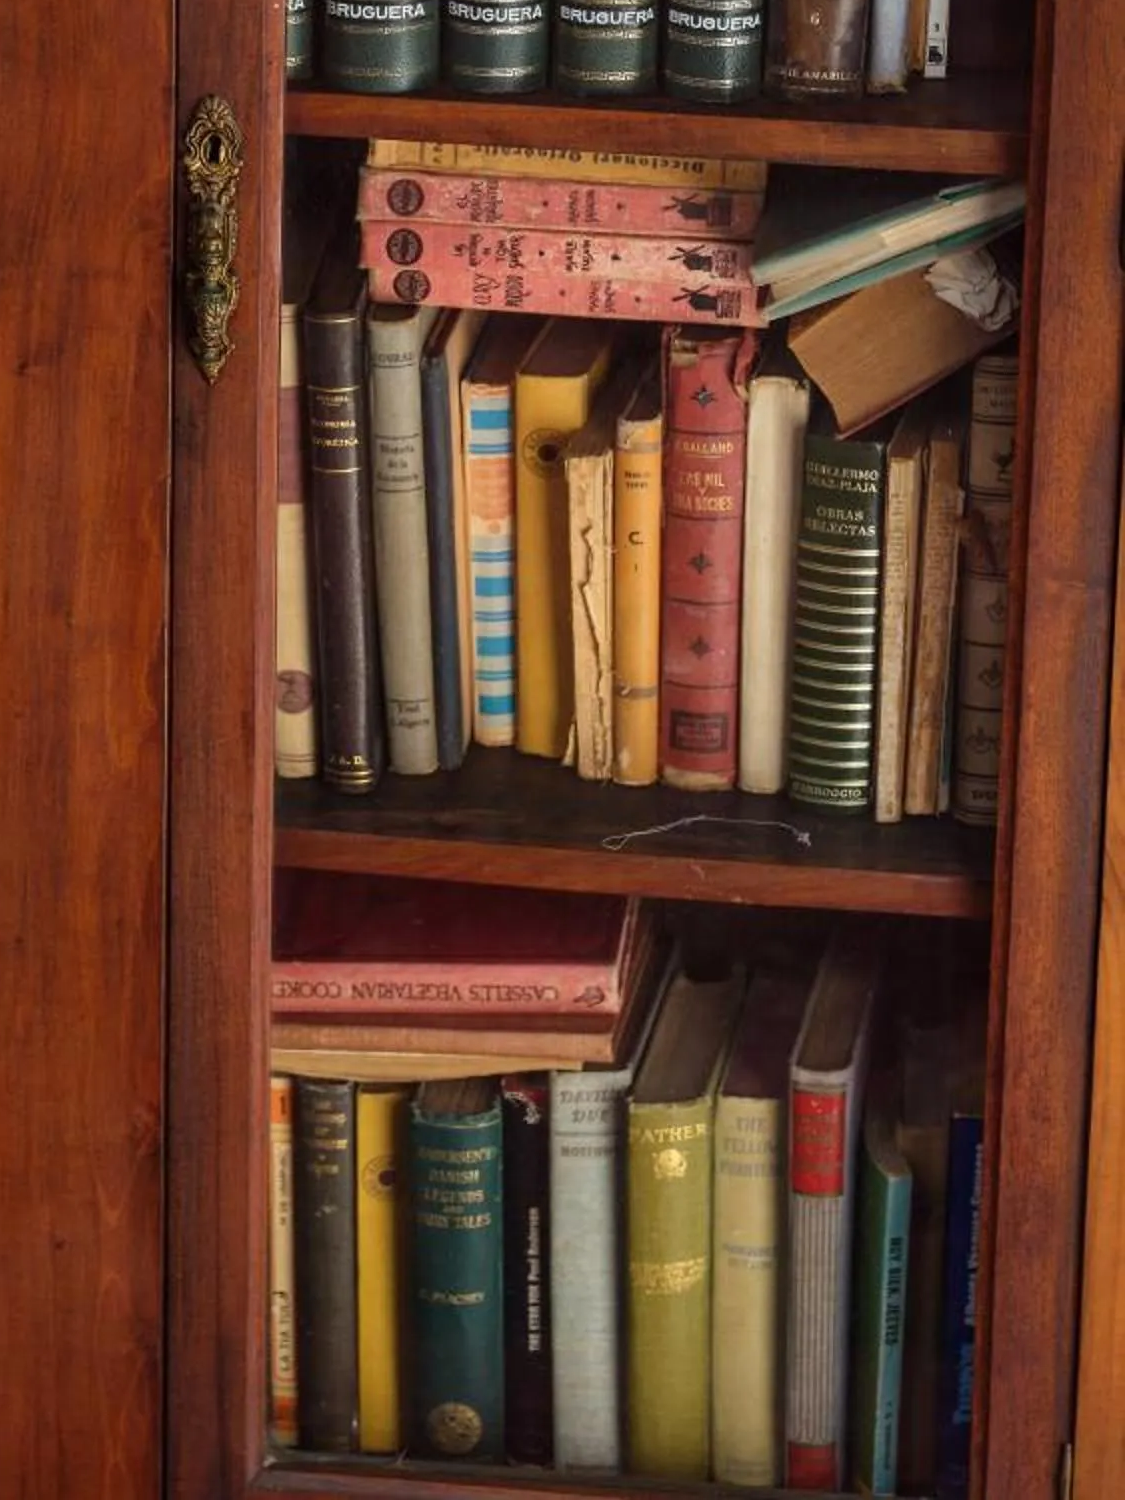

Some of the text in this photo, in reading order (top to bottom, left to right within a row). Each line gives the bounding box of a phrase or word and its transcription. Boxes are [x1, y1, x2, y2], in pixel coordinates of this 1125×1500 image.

[326, 0, 426, 21] BRUGUERA
[448, 0, 544, 23] BRUGUERA
[560, 5, 656, 26] BRUGUERA
[668, 9, 762, 31] BRUGUERA
[592, 152, 706, 175] Diccionari
[816, 506, 865, 524] OBRAS
[805, 518, 877, 538] SELECTAS
[270, 980, 559, 1002] CASSELL'S VEGETARIAN COOKE
